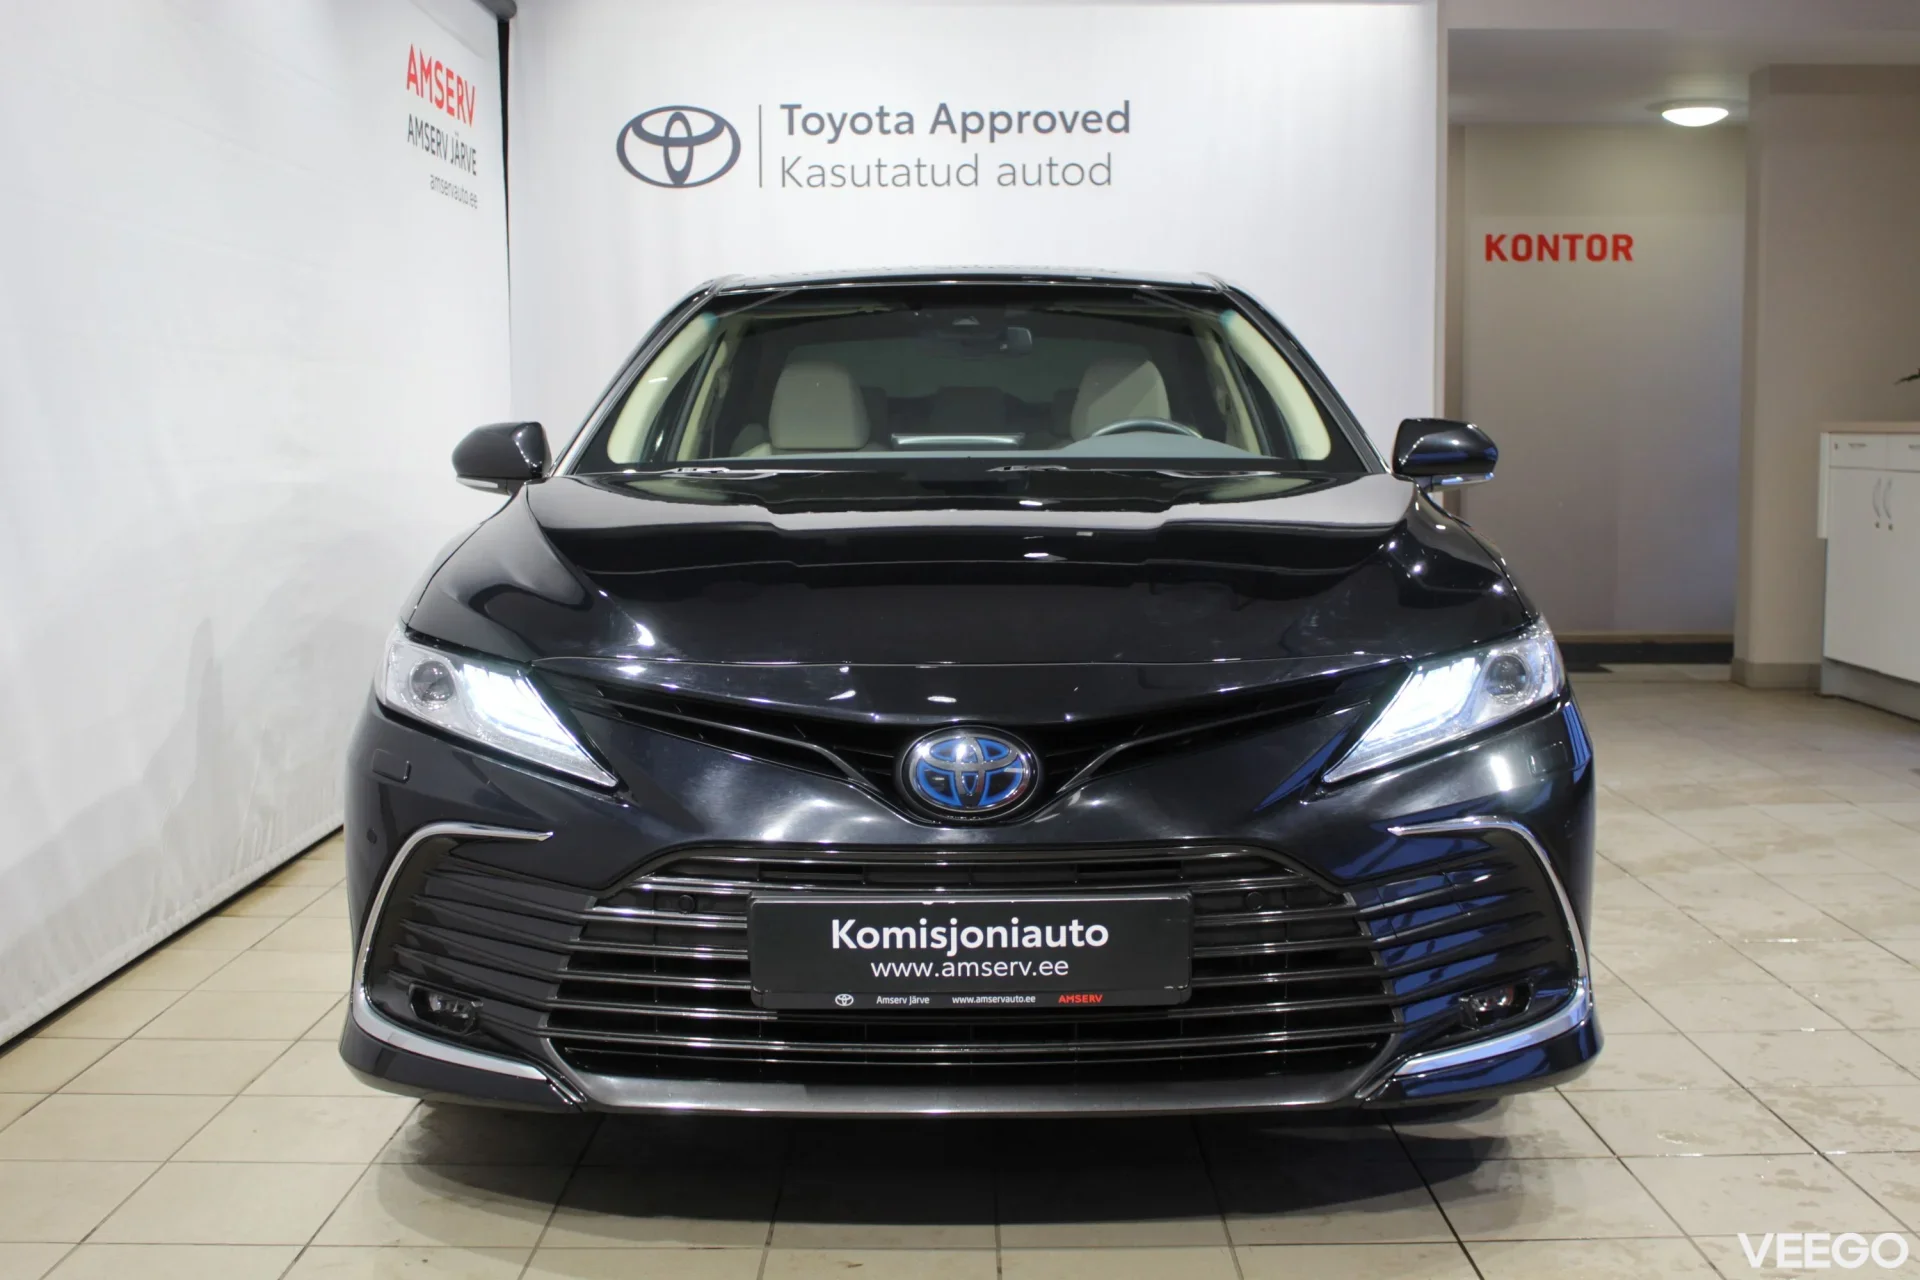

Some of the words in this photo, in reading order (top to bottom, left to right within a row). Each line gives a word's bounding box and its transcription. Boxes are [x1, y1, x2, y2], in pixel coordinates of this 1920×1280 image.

[406, 43, 475, 128] AMSERV
[780, 103, 915, 144] Toyota
[929, 100, 1131, 143] Approved
[407, 113, 448, 161] AMSERV
[450, 131, 477, 176] JÄRVE
[781, 153, 979, 188] Kasutatud
[997, 152, 1112, 187] autod
[430, 174, 478, 209] amservauto.ee
[1485, 234, 1634, 262] KONTOR
[831, 917, 1109, 957] Komisjoniauto
[870, 959, 1069, 978] www.amserv.ee
[876, 995, 907, 1005] Amserv
[908, 994, 930, 1006] Järve
[952, 994, 1036, 1005] www.amservauto.ee
[1058, 994, 1103, 1004] AMSERV
